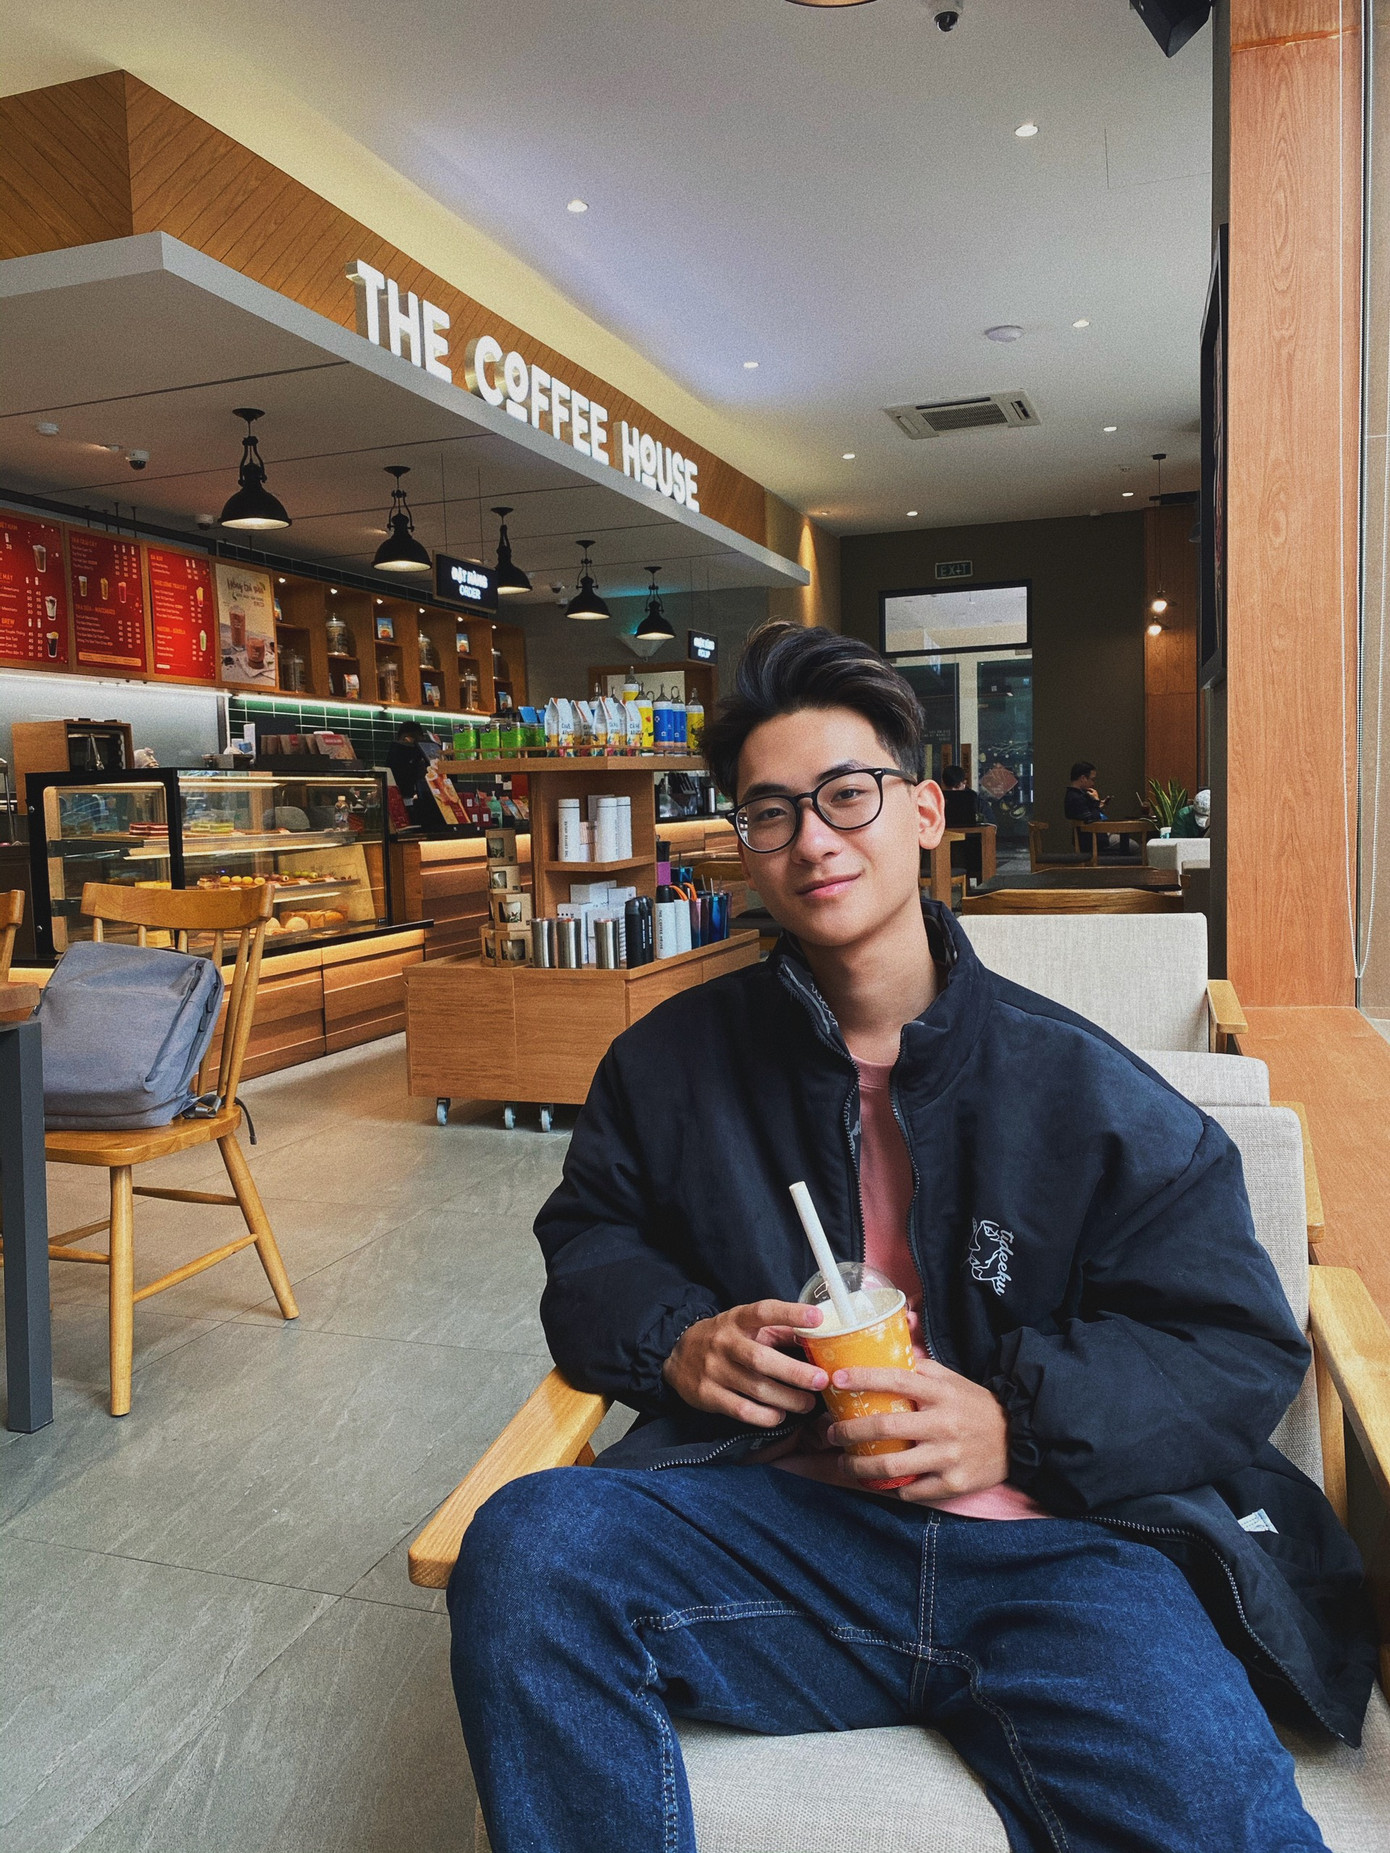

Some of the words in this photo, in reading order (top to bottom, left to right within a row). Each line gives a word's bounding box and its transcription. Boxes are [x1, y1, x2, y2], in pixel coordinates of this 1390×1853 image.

[347, 259, 453, 383] THE
[467, 335, 610, 466] COFFEE
[614, 420, 700, 513] HOUSE
[459, 584, 481, 600] ORDER
